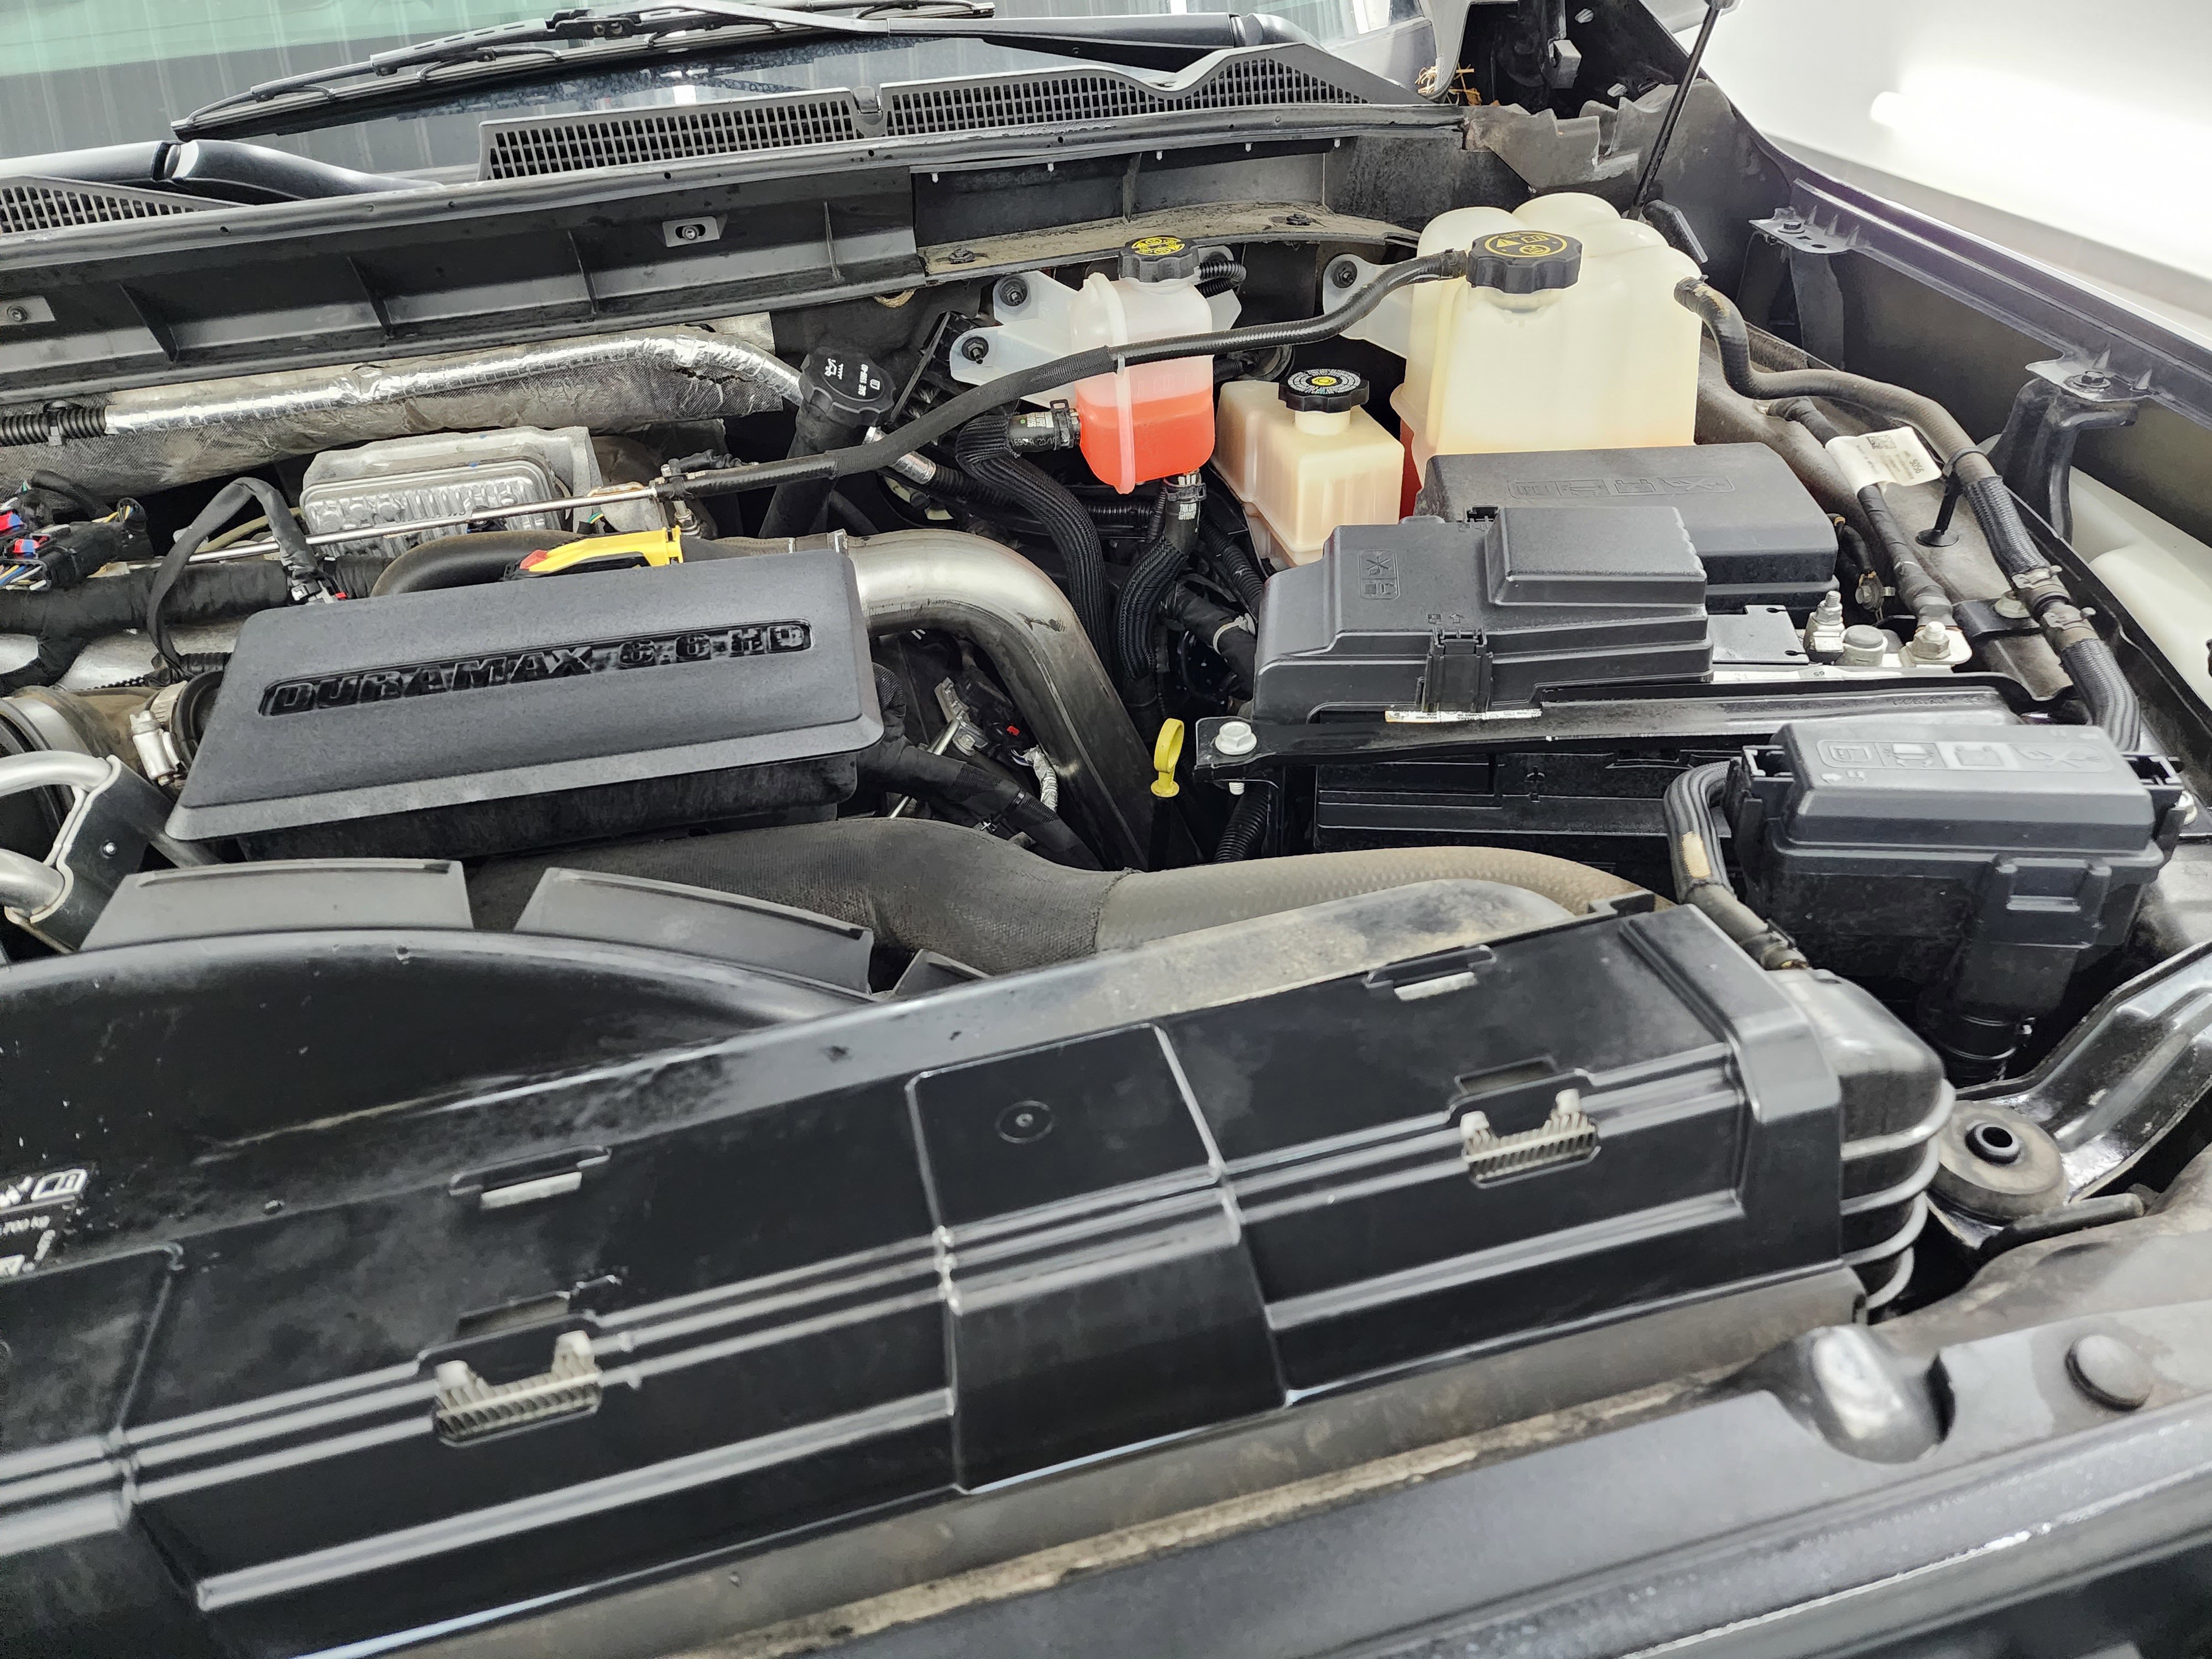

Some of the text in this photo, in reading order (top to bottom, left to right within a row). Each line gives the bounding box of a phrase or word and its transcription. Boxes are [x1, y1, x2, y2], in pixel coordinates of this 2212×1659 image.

[1909, 459, 1924, 473] 5056
[269, 625, 804, 716] DURAMAX 6.6 HD
